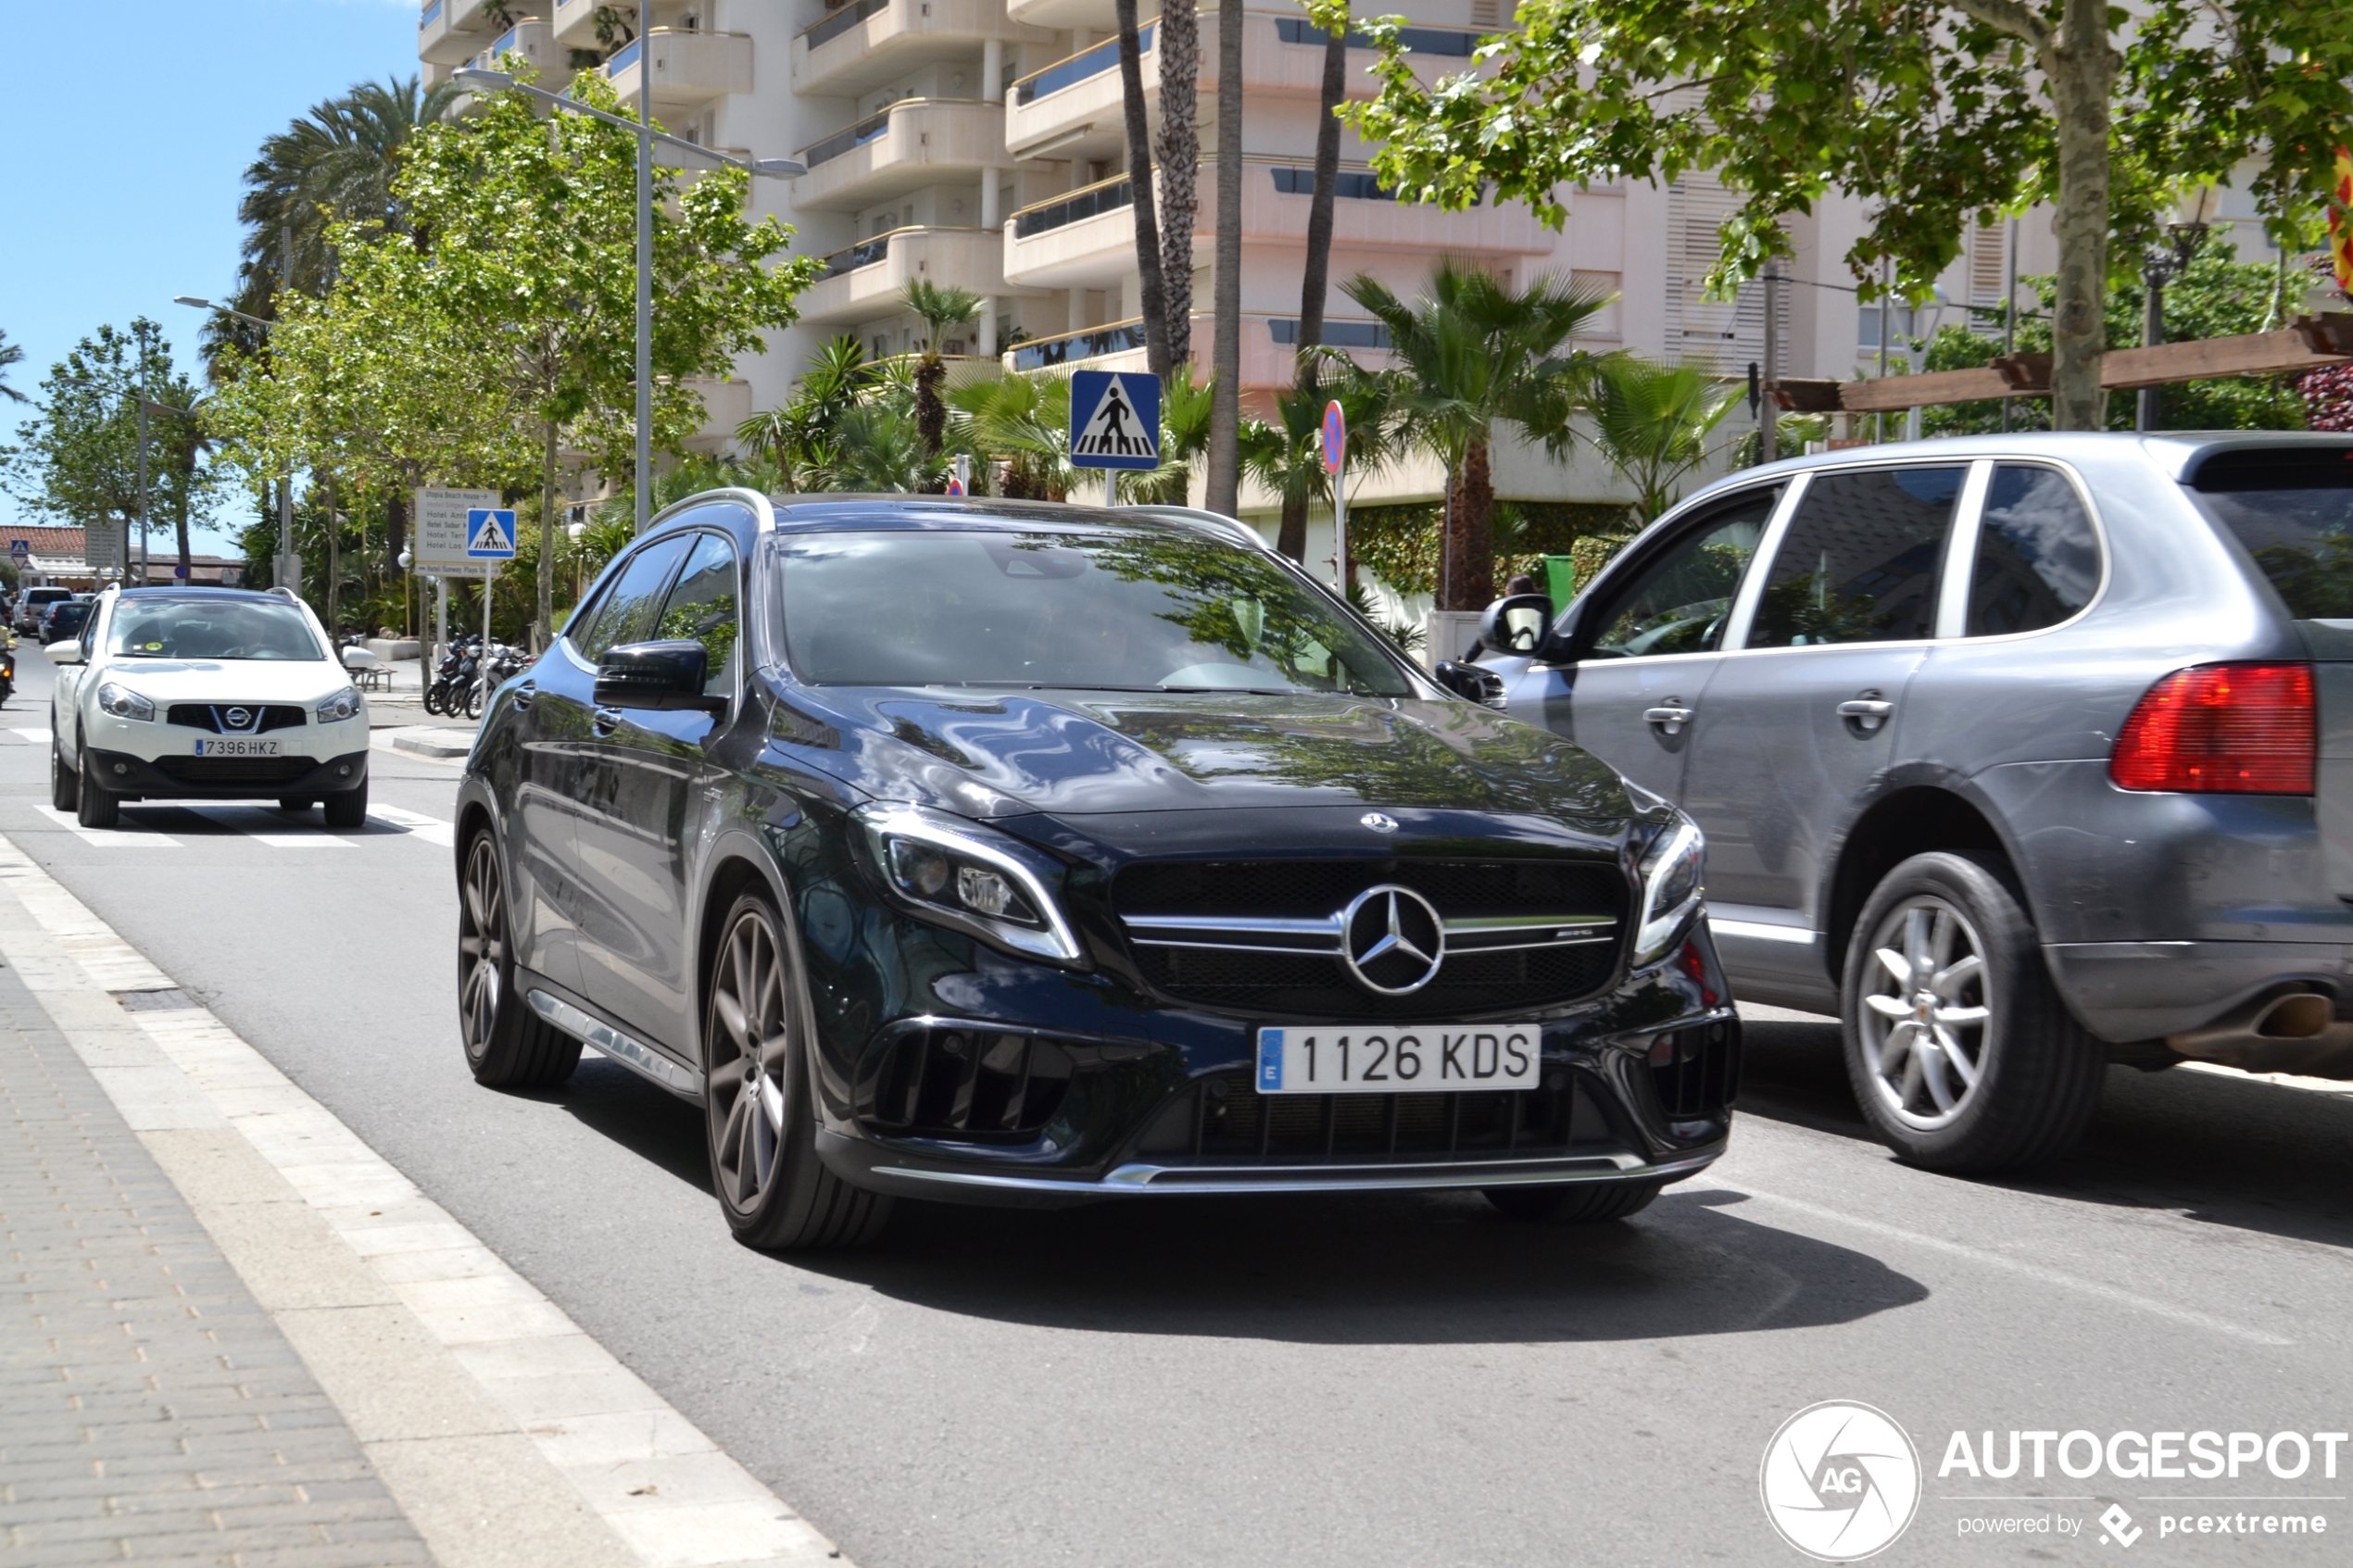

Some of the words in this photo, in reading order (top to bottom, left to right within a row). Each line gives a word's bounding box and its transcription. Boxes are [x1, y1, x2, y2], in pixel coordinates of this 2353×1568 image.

[426, 491, 443, 500] Utopia
[426, 510, 447, 519] Hotel
[426, 521, 442, 529] Hotel
[426, 531, 447, 539] Hotel
[442, 566, 462, 574] Sunway
[206, 741, 245, 755] 7396
[248, 742, 277, 755] HKZ
[1303, 1035, 1421, 1082] 1126
[1441, 1034, 1529, 1079] KDS
[1265, 1067, 1276, 1080] E
